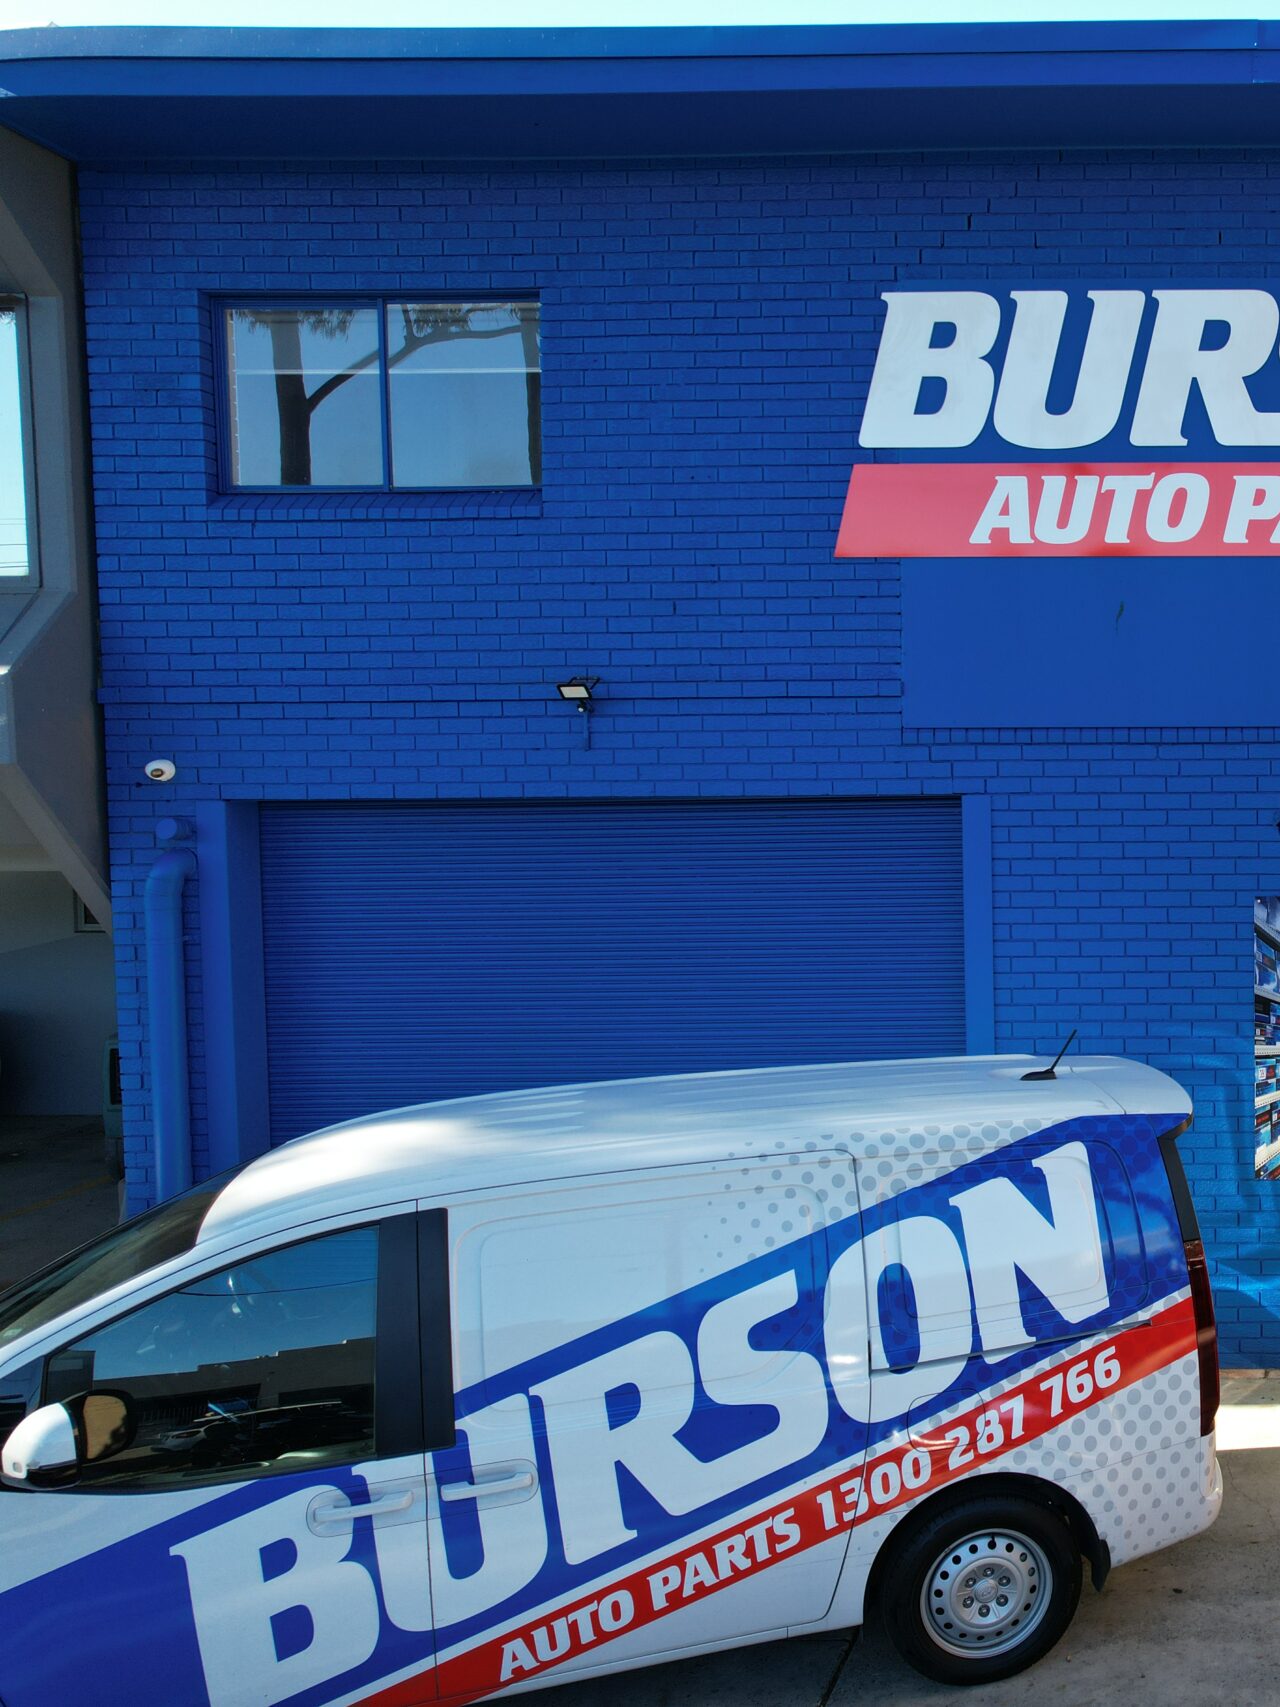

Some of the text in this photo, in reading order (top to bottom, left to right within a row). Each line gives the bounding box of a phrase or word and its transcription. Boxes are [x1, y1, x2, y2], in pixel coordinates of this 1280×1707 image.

[968, 472, 1211, 546] AUTO
[169, 1140, 1110, 1707] BURSON
[500, 1345, 1121, 1682] AUTO PARTS 1300 287 766
